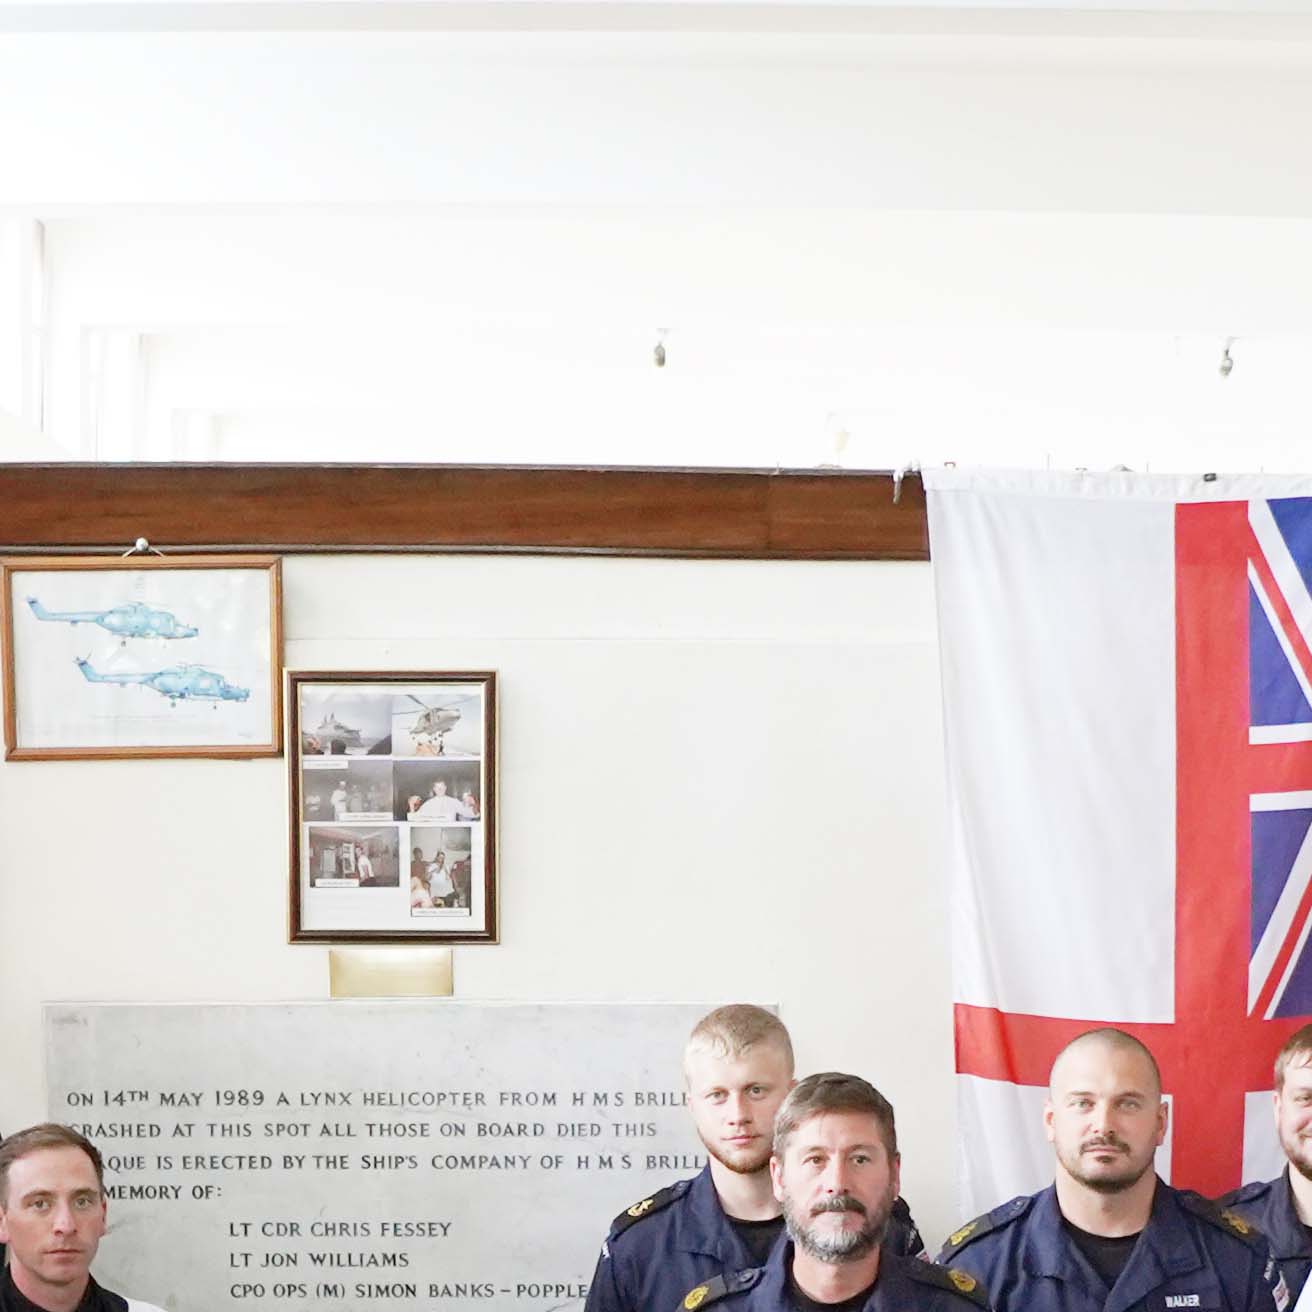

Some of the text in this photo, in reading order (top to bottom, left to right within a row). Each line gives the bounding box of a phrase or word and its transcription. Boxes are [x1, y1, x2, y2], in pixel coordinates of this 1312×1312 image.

[66, 1091, 94, 1107] ON
[159, 1092, 204, 1108] MAY
[215, 1088, 265, 1107] 1989
[275, 1091, 291, 1107] A
[300, 1091, 353, 1107] LYNX
[362, 1091, 487, 1108] HELICOPTER
[499, 1091, 557, 1107] FROM
[571, 1091, 585, 1107] H
[592, 1091, 609, 1107] M
[613, 1091, 625, 1108] S
[634, 1091, 688, 1107] BRILL
[171, 1122, 196, 1138] AT
[206, 1122, 253, 1138] THIS
[263, 1122, 312, 1138] SPOT
[319, 1122, 358, 1138] ALL
[364, 1122, 431, 1138] THOSE
[439, 1122, 466, 1137] ON
[476, 1122, 545, 1138] BOARD
[556, 1122, 602, 1138] DIED
[611, 1122, 657, 1138] THIS
[156, 1155, 173, 1171] IS
[181, 1154, 273, 1171] ERECTED
[282, 1154, 307, 1170] BY
[311, 1154, 350, 1171] THE
[360, 1154, 419, 1170] SHIP'S
[431, 1154, 532, 1170] COMPANY
[539, 1154, 564, 1170] OF
[577, 1155, 590, 1170] H
[598, 1154, 614, 1170] M
[620, 1154, 632, 1170] S
[645, 1154, 703, 1171] BRILL
[191, 1184, 222, 1201] OF:
[229, 1221, 453, 1238] LT CDR CHRIS FESSEY
[229, 1251, 410, 1269] LT JON WILLIAMS
[229, 1283, 266, 1299] CPO
[272, 1283, 308, 1299] OPS
[315, 1283, 346, 1299] (M)
[354, 1282, 417, 1299] SIMON
[428, 1282, 495, 1299] BANKS
